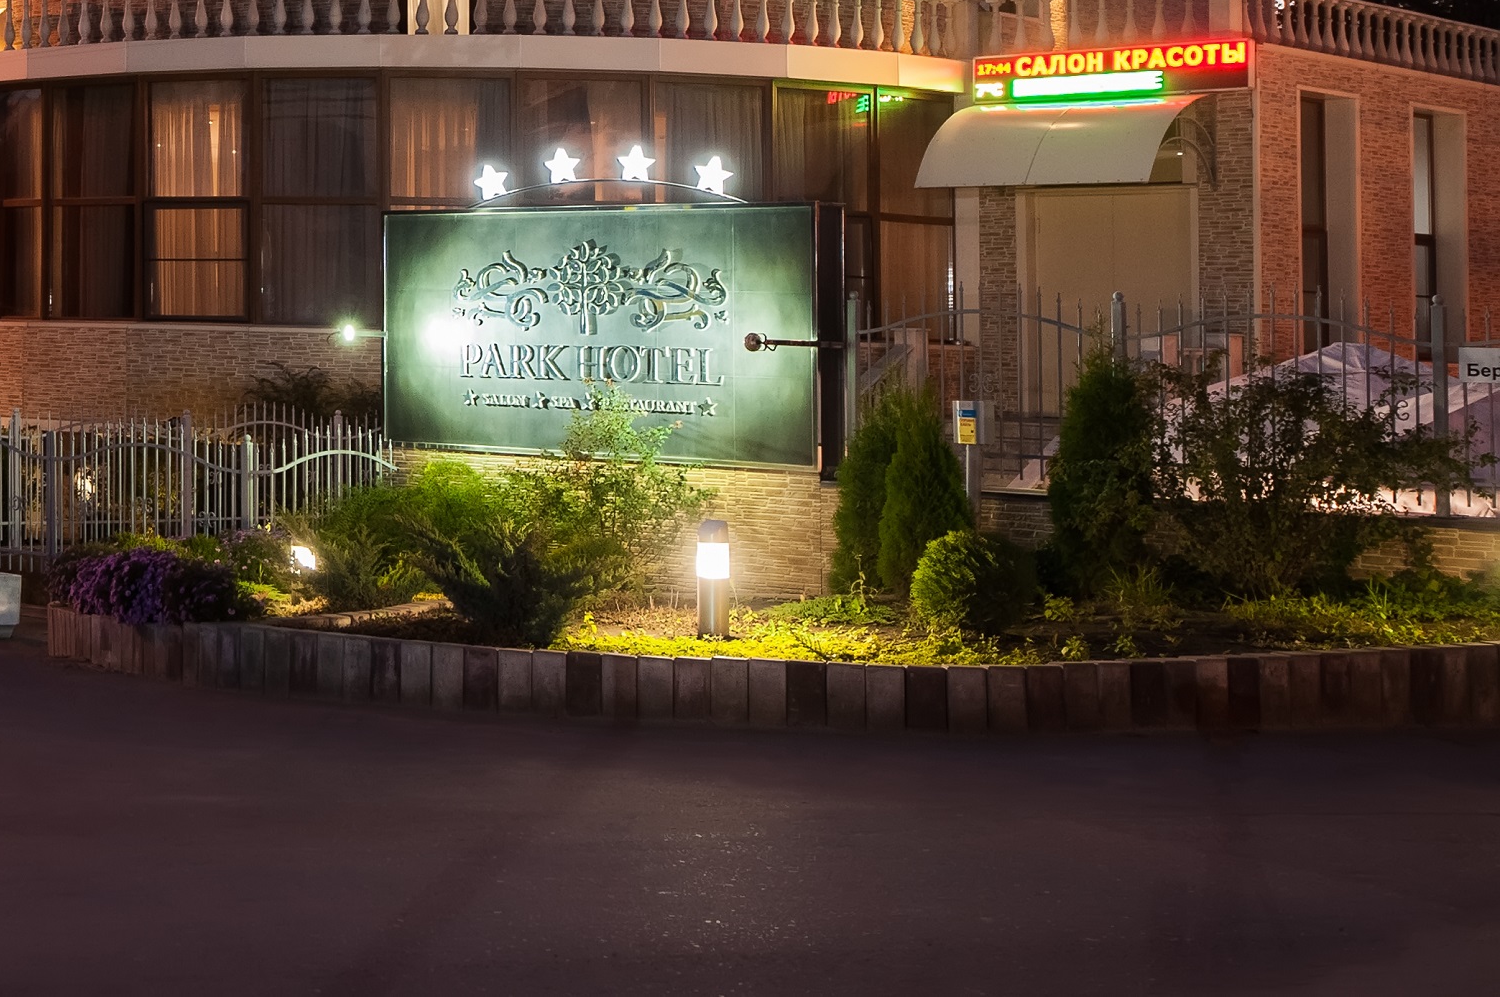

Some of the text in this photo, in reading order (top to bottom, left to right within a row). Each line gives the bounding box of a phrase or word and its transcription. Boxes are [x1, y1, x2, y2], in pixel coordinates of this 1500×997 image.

[1015, 42, 1246, 76] САЛОН КРАСОТЫ
[461, 343, 725, 387] PARK HOTEL
[481, 393, 530, 408] SALON
[549, 396, 580, 410] SPA
